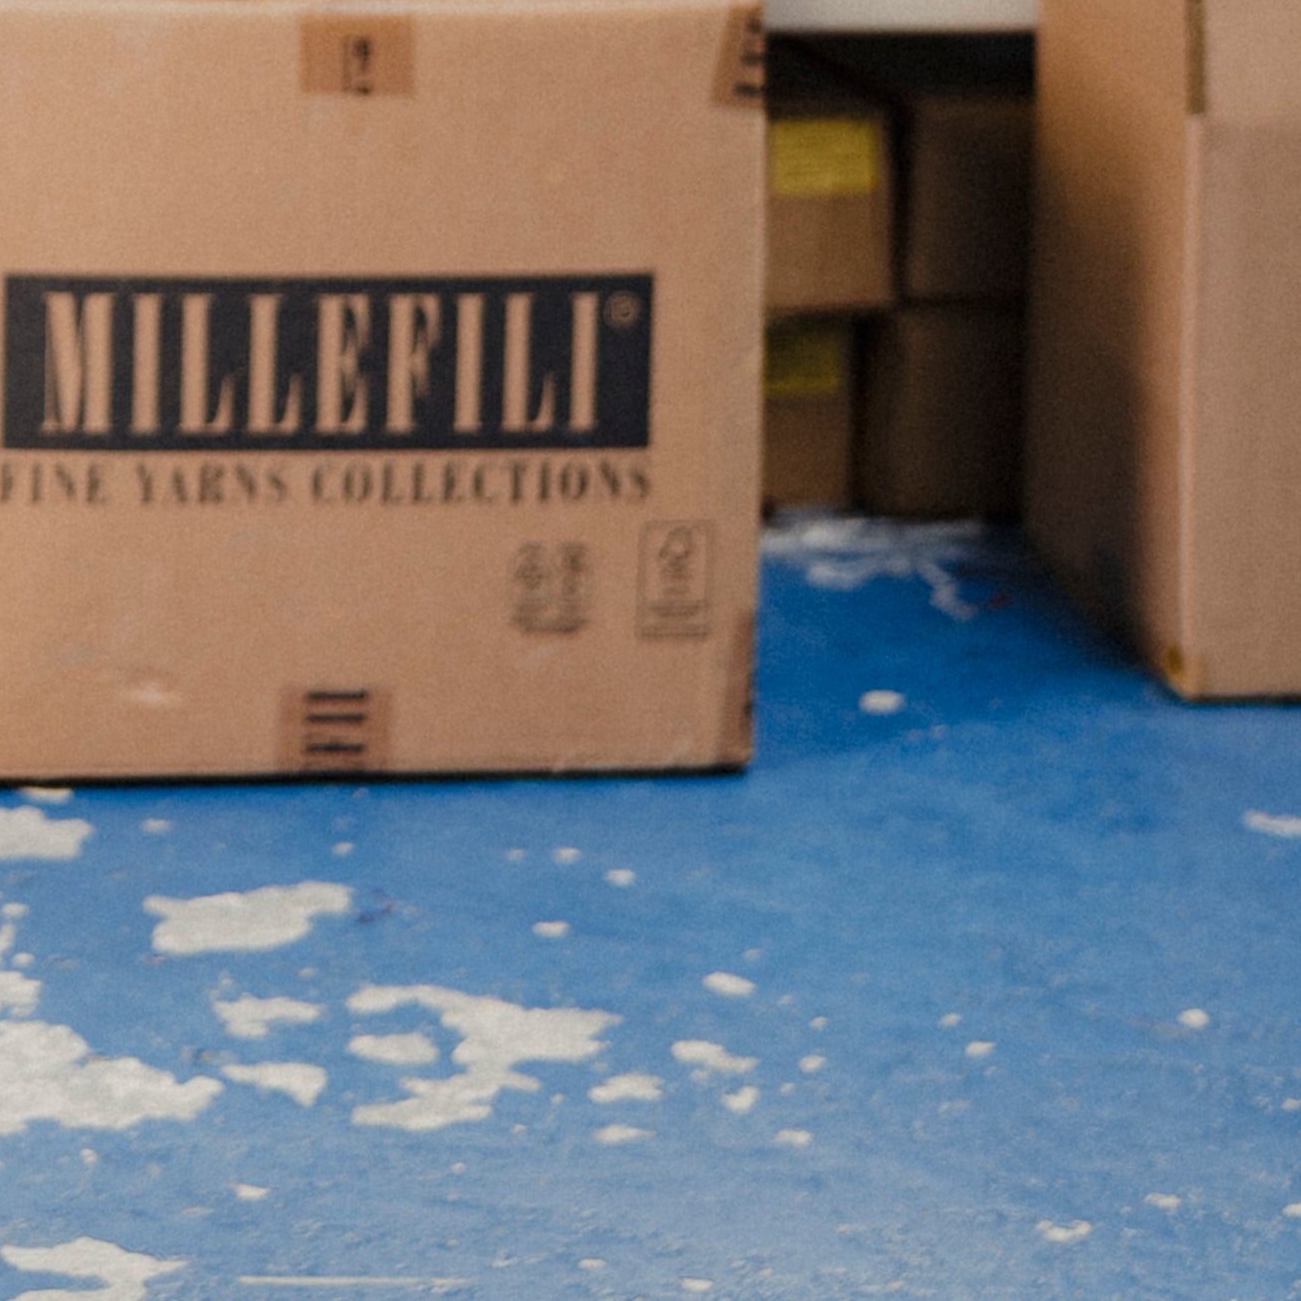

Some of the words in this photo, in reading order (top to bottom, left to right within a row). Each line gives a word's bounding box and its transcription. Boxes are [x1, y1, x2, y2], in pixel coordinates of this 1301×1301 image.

[0, 458, 111, 506] FINE
[133, 456, 287, 505] YARNS
[311, 454, 652, 504] COLLECTIONS
